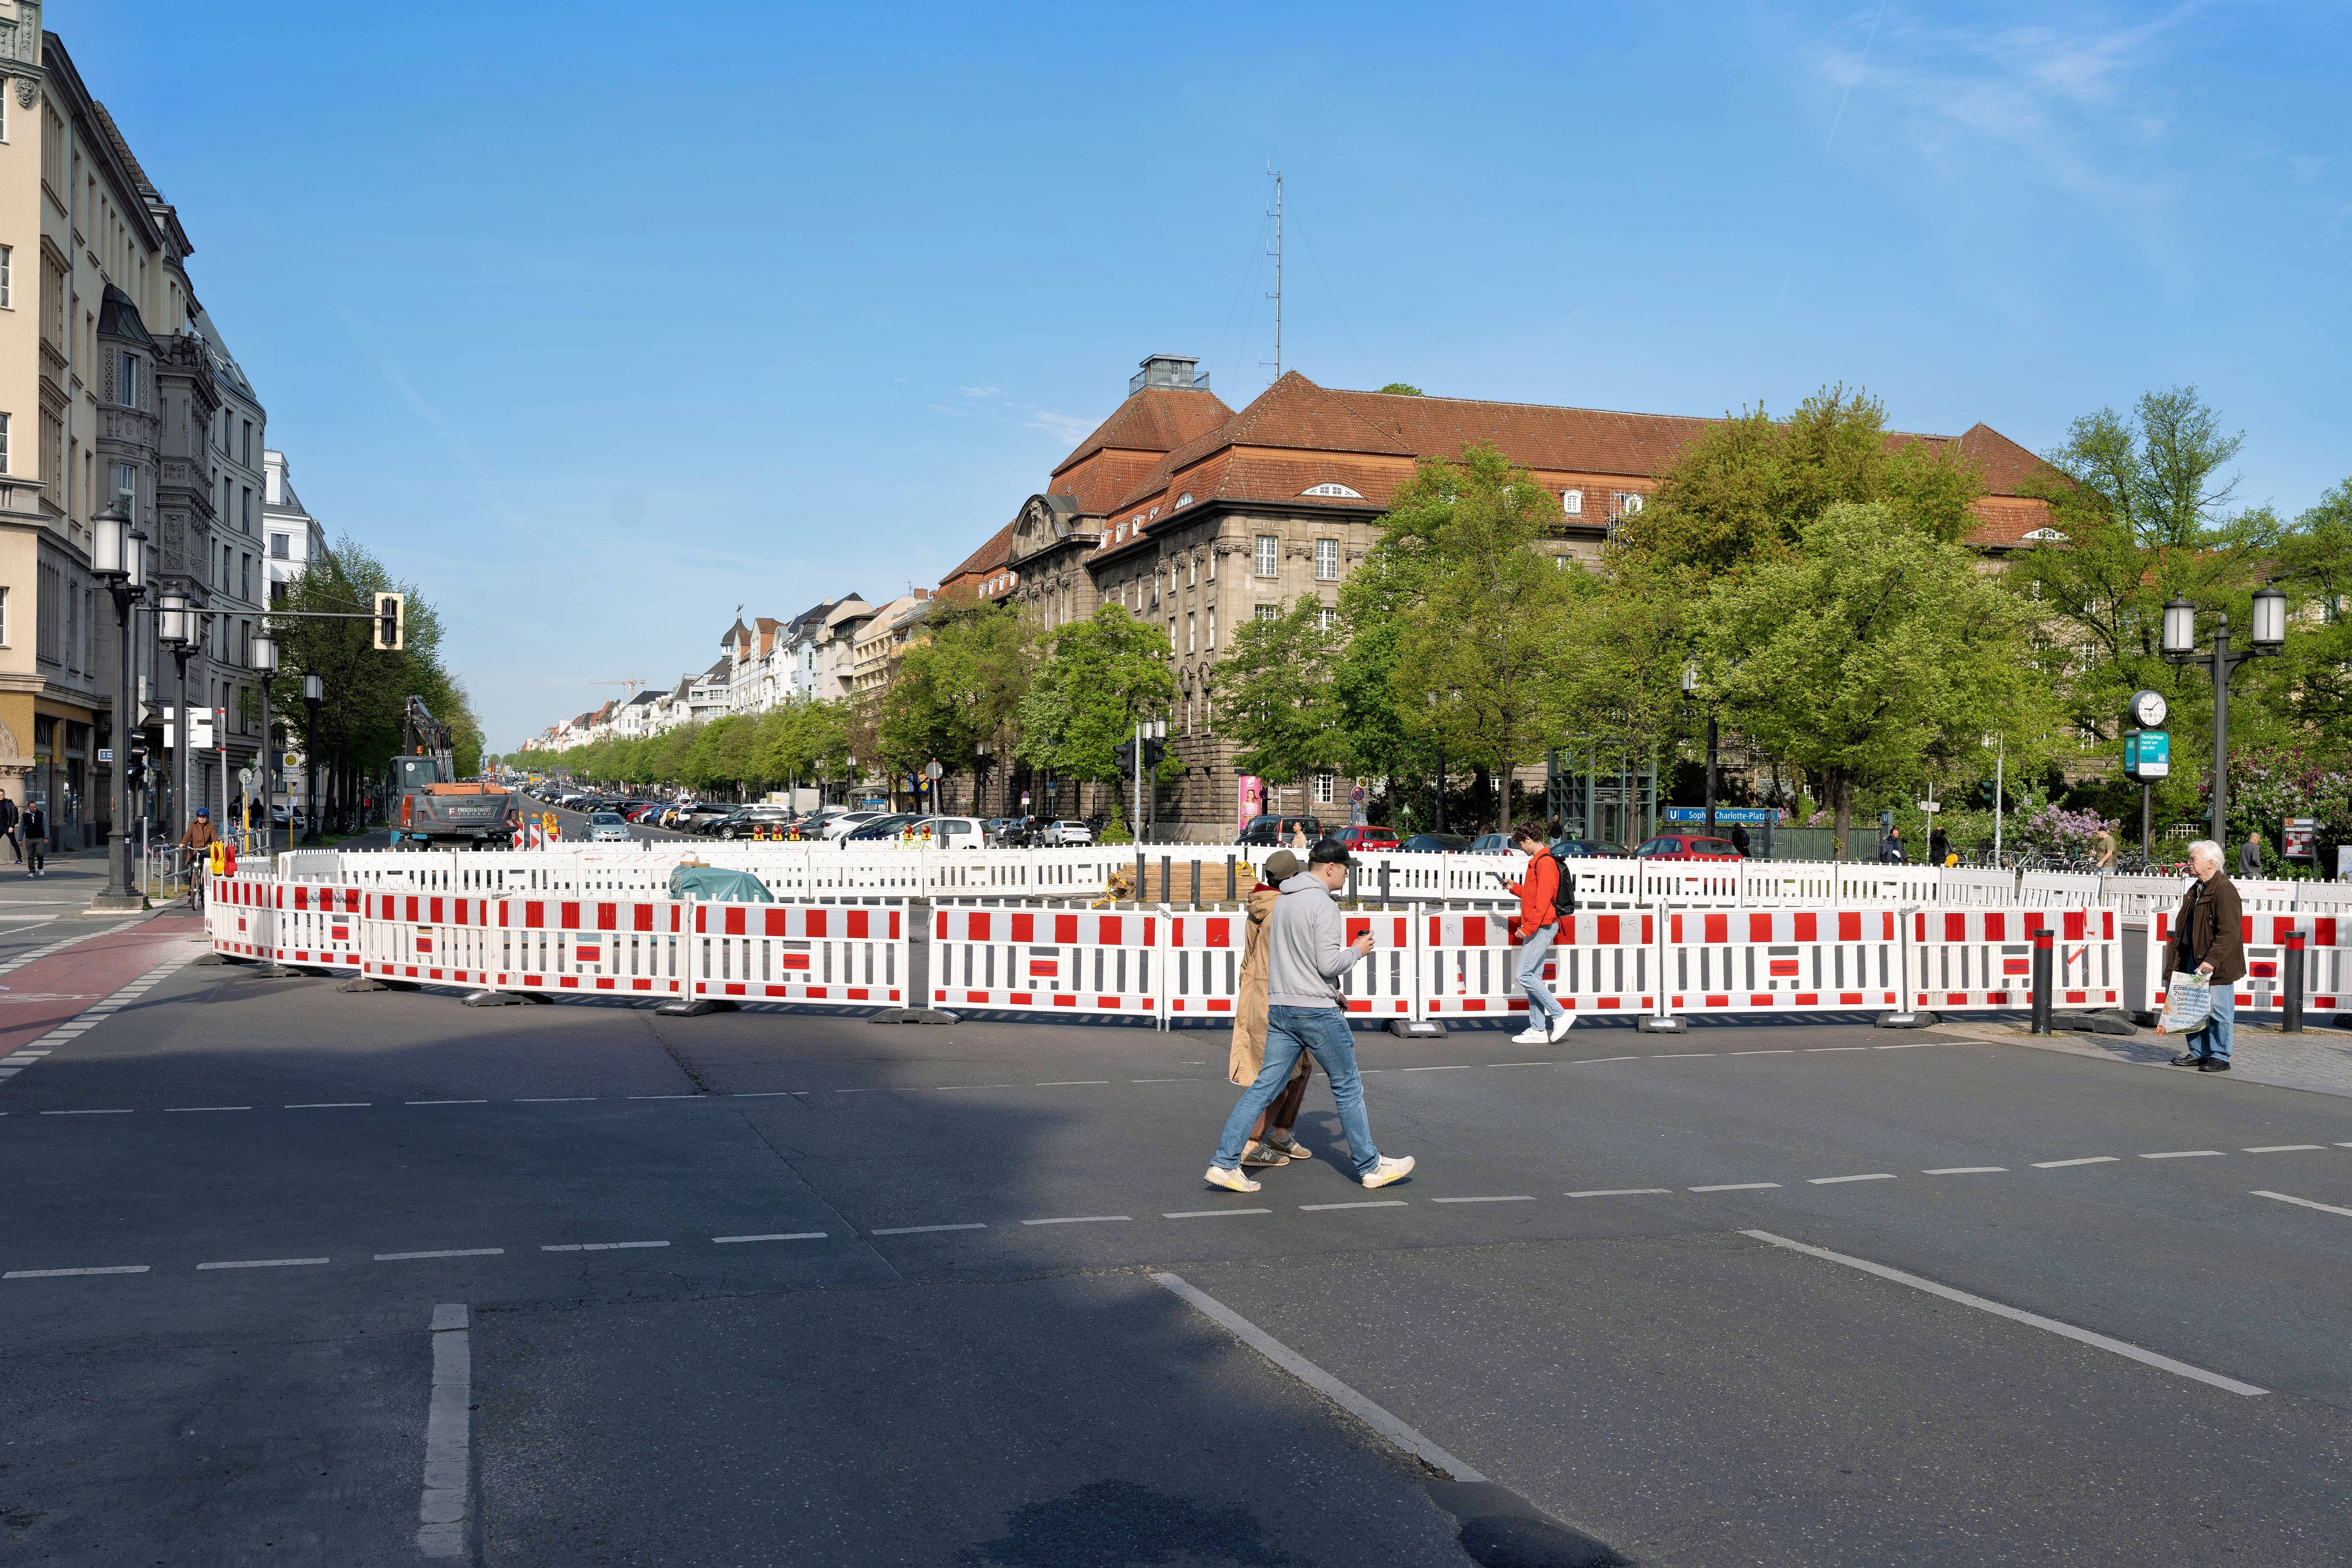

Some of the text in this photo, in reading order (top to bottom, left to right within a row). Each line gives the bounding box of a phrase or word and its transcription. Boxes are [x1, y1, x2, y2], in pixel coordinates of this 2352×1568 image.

[1670, 810, 1677, 819] U
[1689, 811, 1765, 820] SophCharlotte-Platz
[1446, 924, 1455, 935] R
[1260, 1151, 1272, 1161] N
